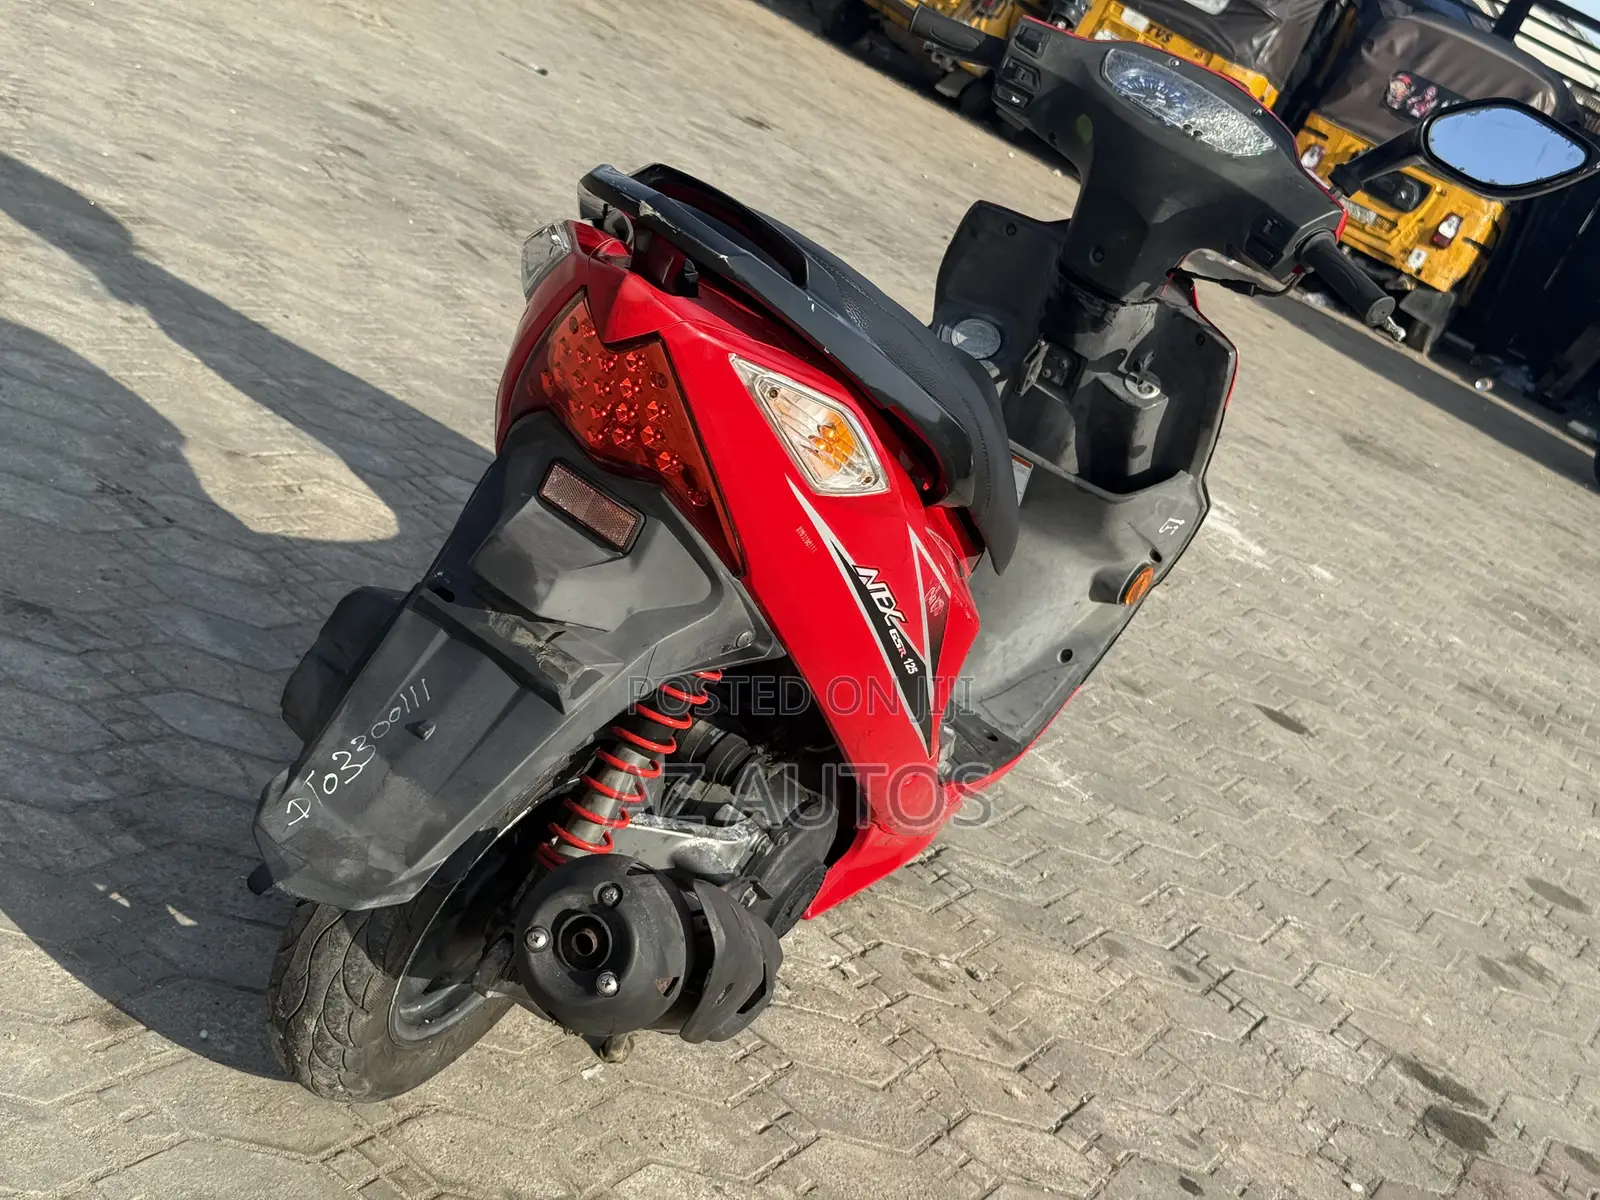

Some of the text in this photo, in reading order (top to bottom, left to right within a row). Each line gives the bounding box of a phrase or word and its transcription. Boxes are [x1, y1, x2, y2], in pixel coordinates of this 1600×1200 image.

[1145, 22, 1173, 43] TVS
[852, 565, 909, 626] NEX
[903, 657, 918, 675] 125
